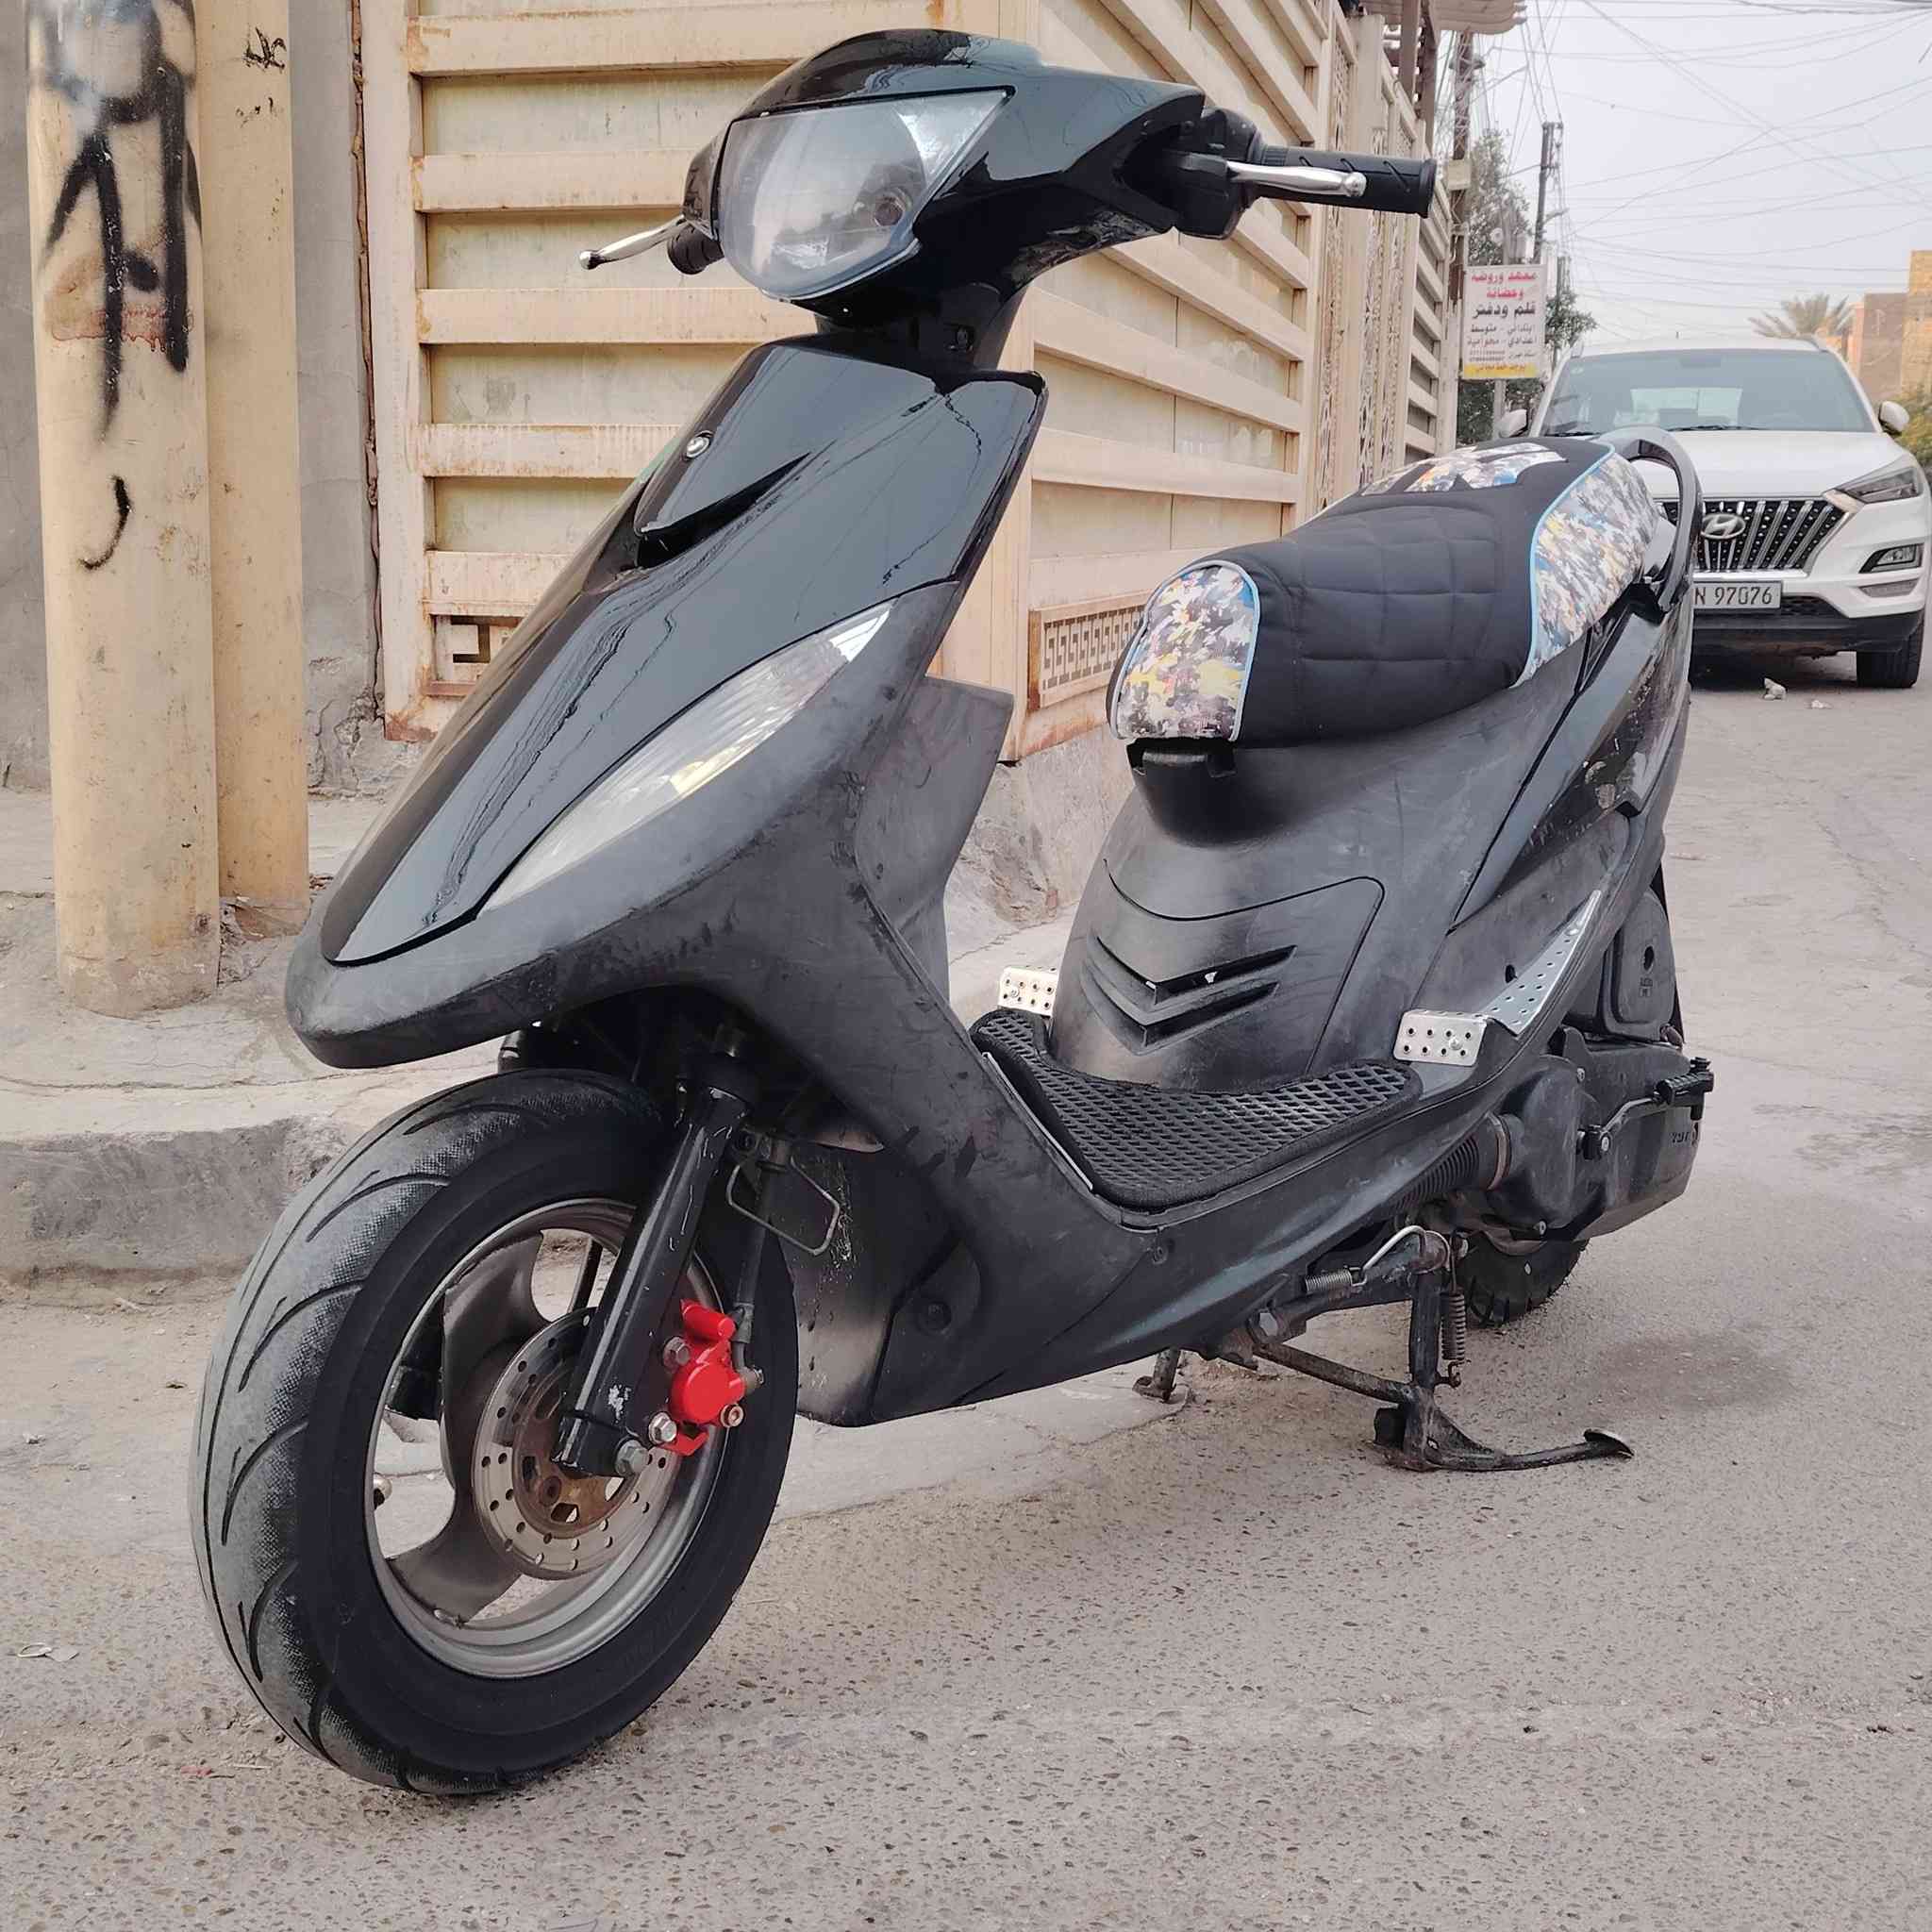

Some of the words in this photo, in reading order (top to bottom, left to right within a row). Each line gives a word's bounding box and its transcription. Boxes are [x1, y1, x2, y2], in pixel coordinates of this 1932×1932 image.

[1472, 301, 1508, 319] ودفتر
[1513, 301, 1536, 318] قلم
[1714, 586, 1773, 606] 97076
